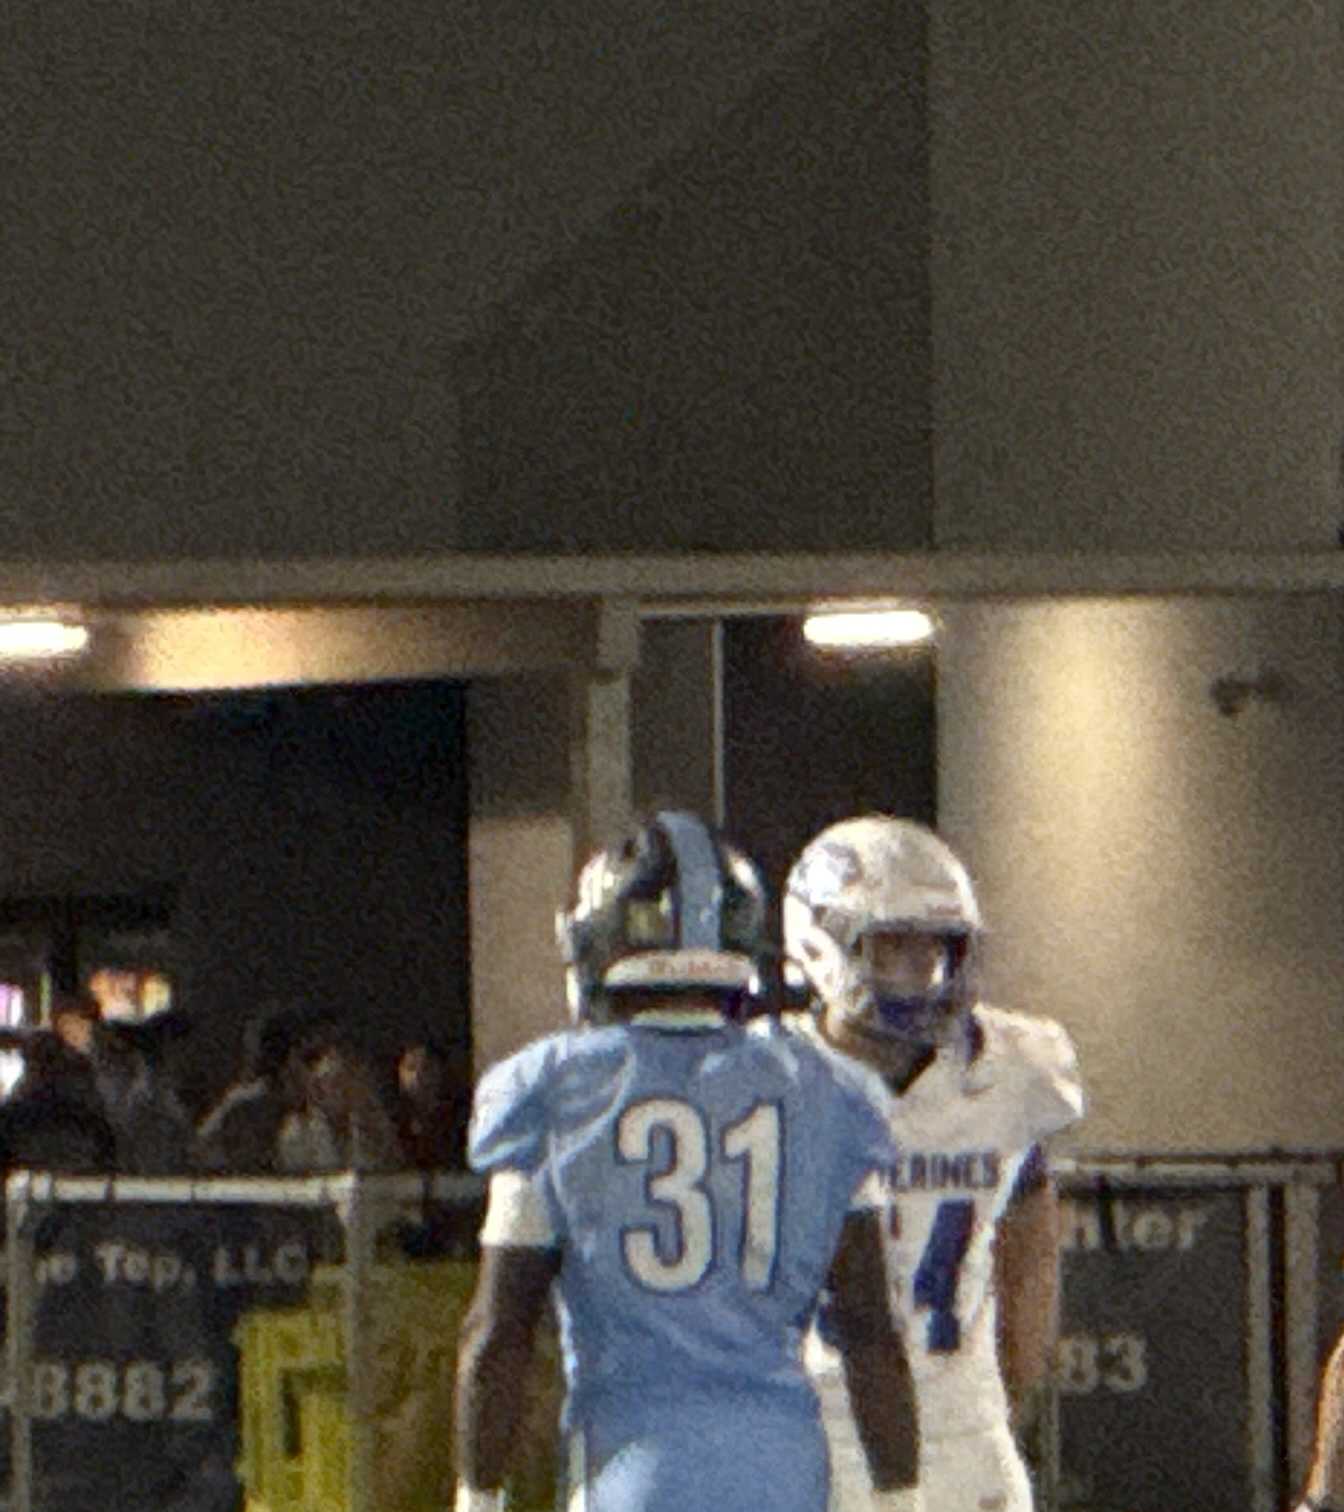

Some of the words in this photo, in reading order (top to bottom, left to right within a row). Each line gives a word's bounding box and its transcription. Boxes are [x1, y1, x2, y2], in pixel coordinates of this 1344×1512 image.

[884, 1150, 1000, 1190] ERINES
[614, 1097, 783, 1294] 31
[213, 1245, 307, 1284] LLC
